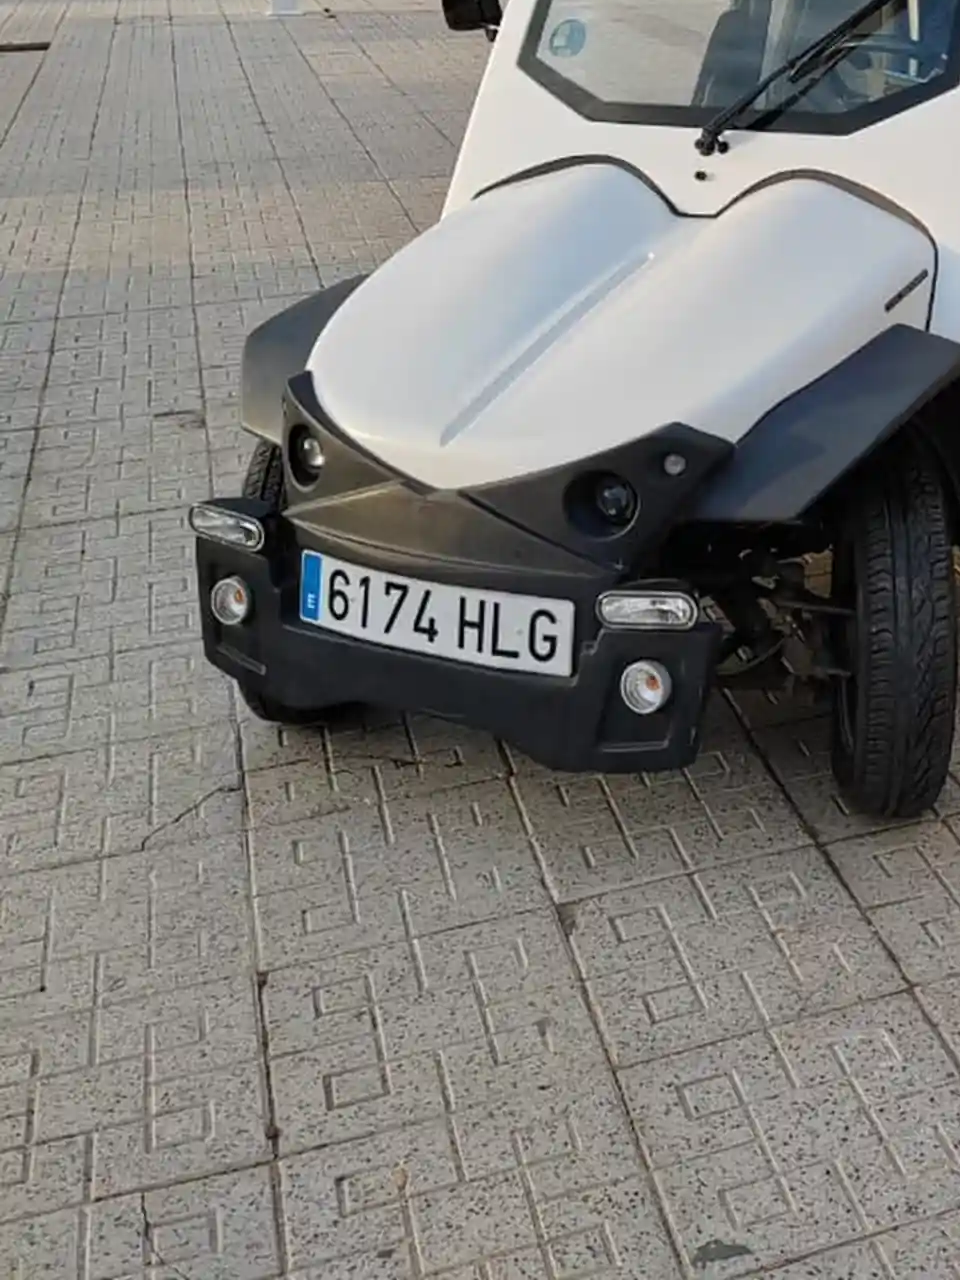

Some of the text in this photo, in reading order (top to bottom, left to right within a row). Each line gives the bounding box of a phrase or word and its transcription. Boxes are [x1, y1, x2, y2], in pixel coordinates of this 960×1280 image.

[307, 569, 558, 663] E 6174 HLG
